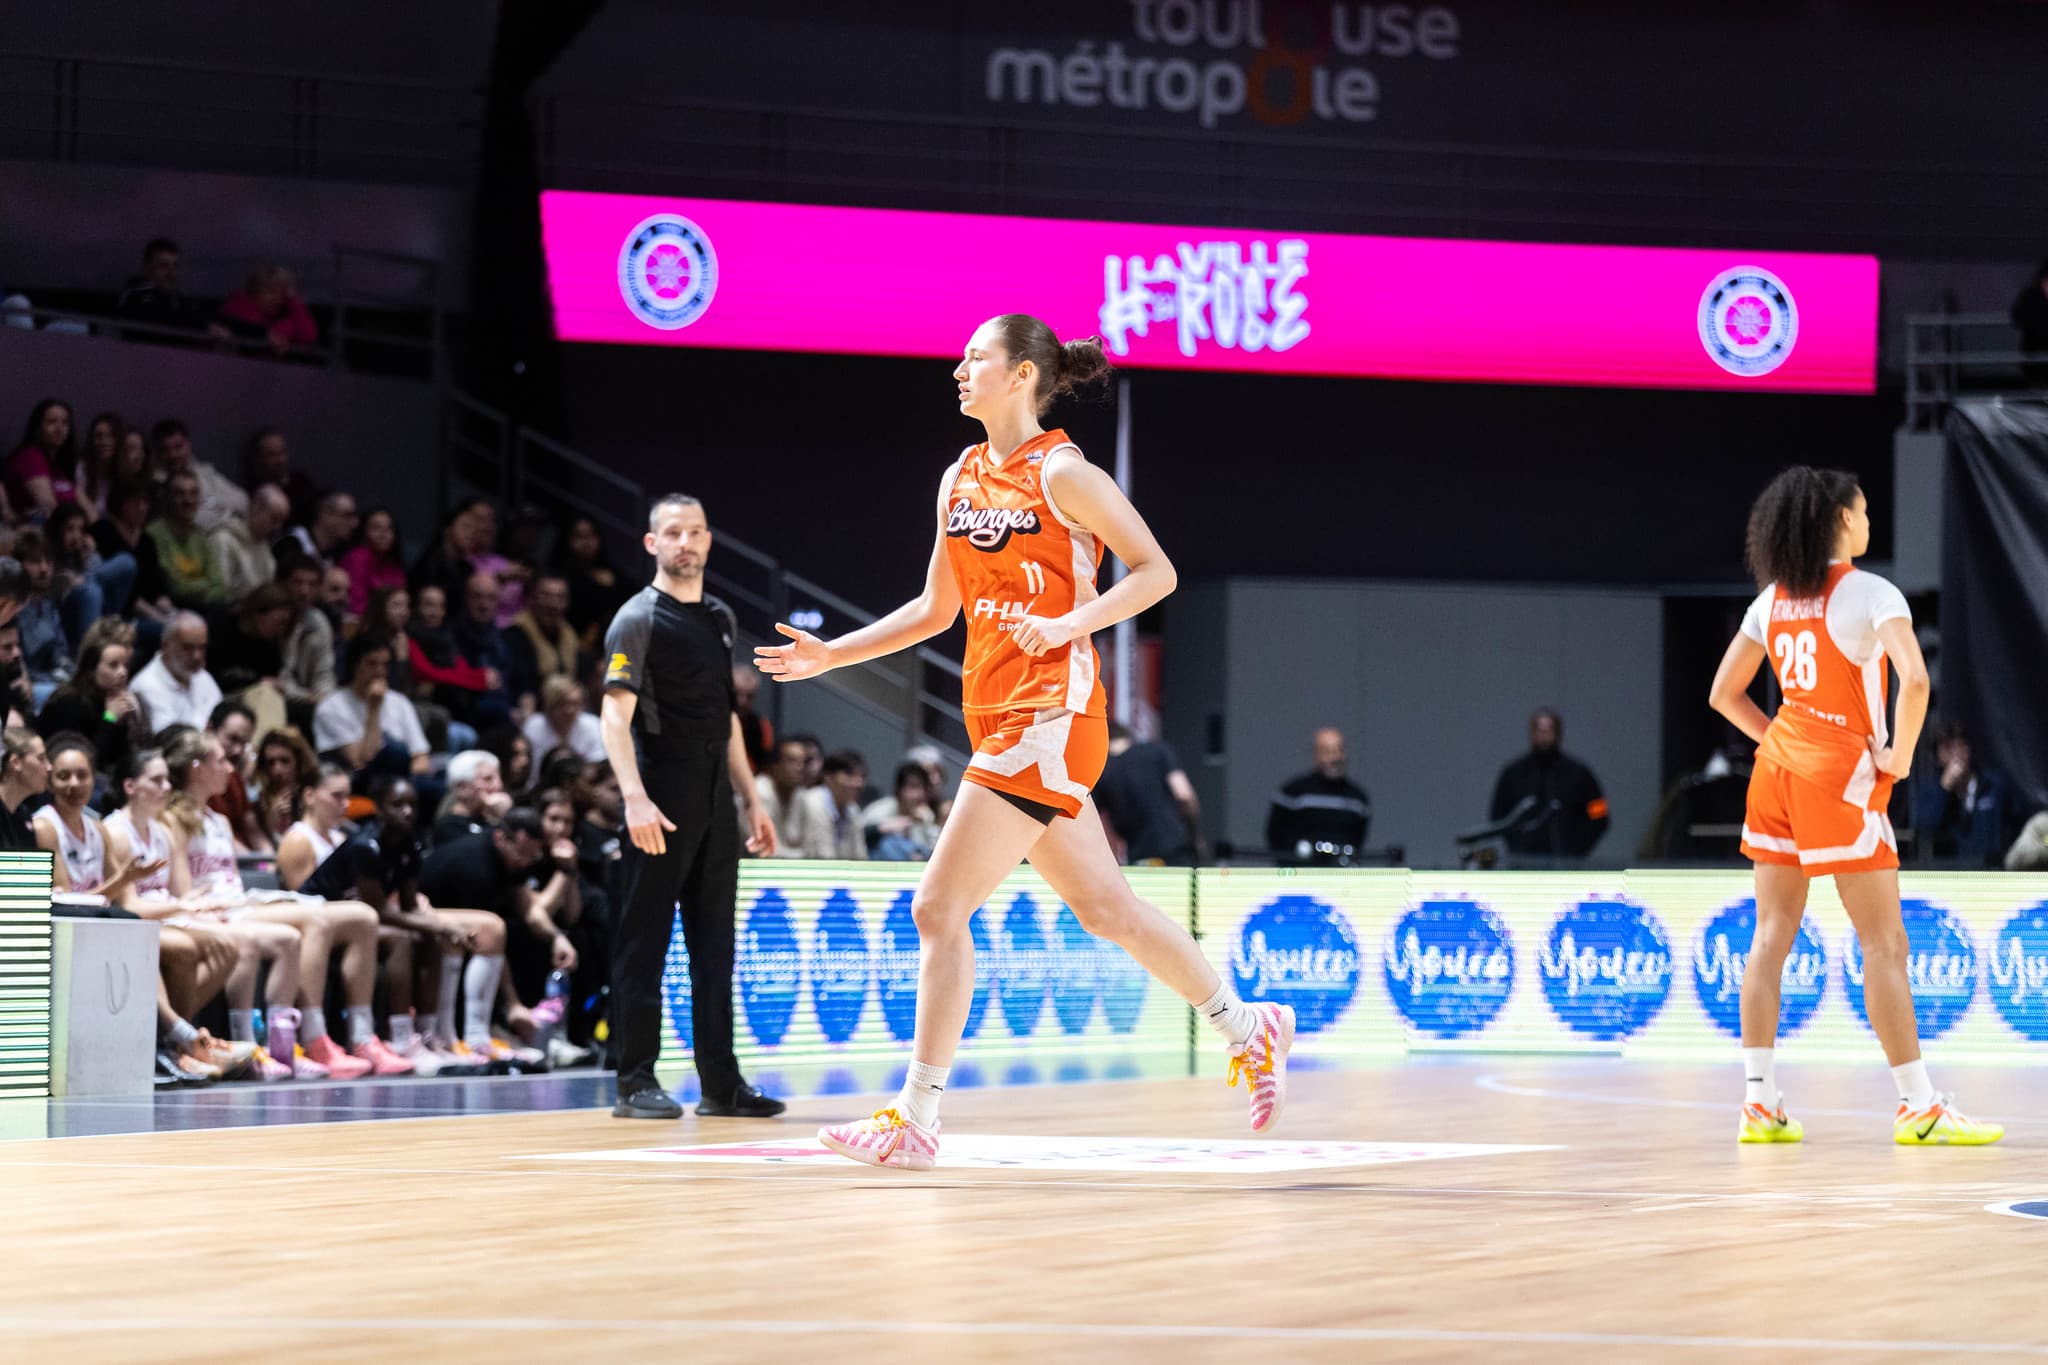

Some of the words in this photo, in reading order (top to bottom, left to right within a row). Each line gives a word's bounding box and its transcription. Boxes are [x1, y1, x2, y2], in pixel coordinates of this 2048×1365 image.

[986, 40, 1381, 127] métropole
[947, 498, 1037, 547] Bourges
[1020, 561, 1045, 595] 11
[1775, 630, 1817, 690] 26
